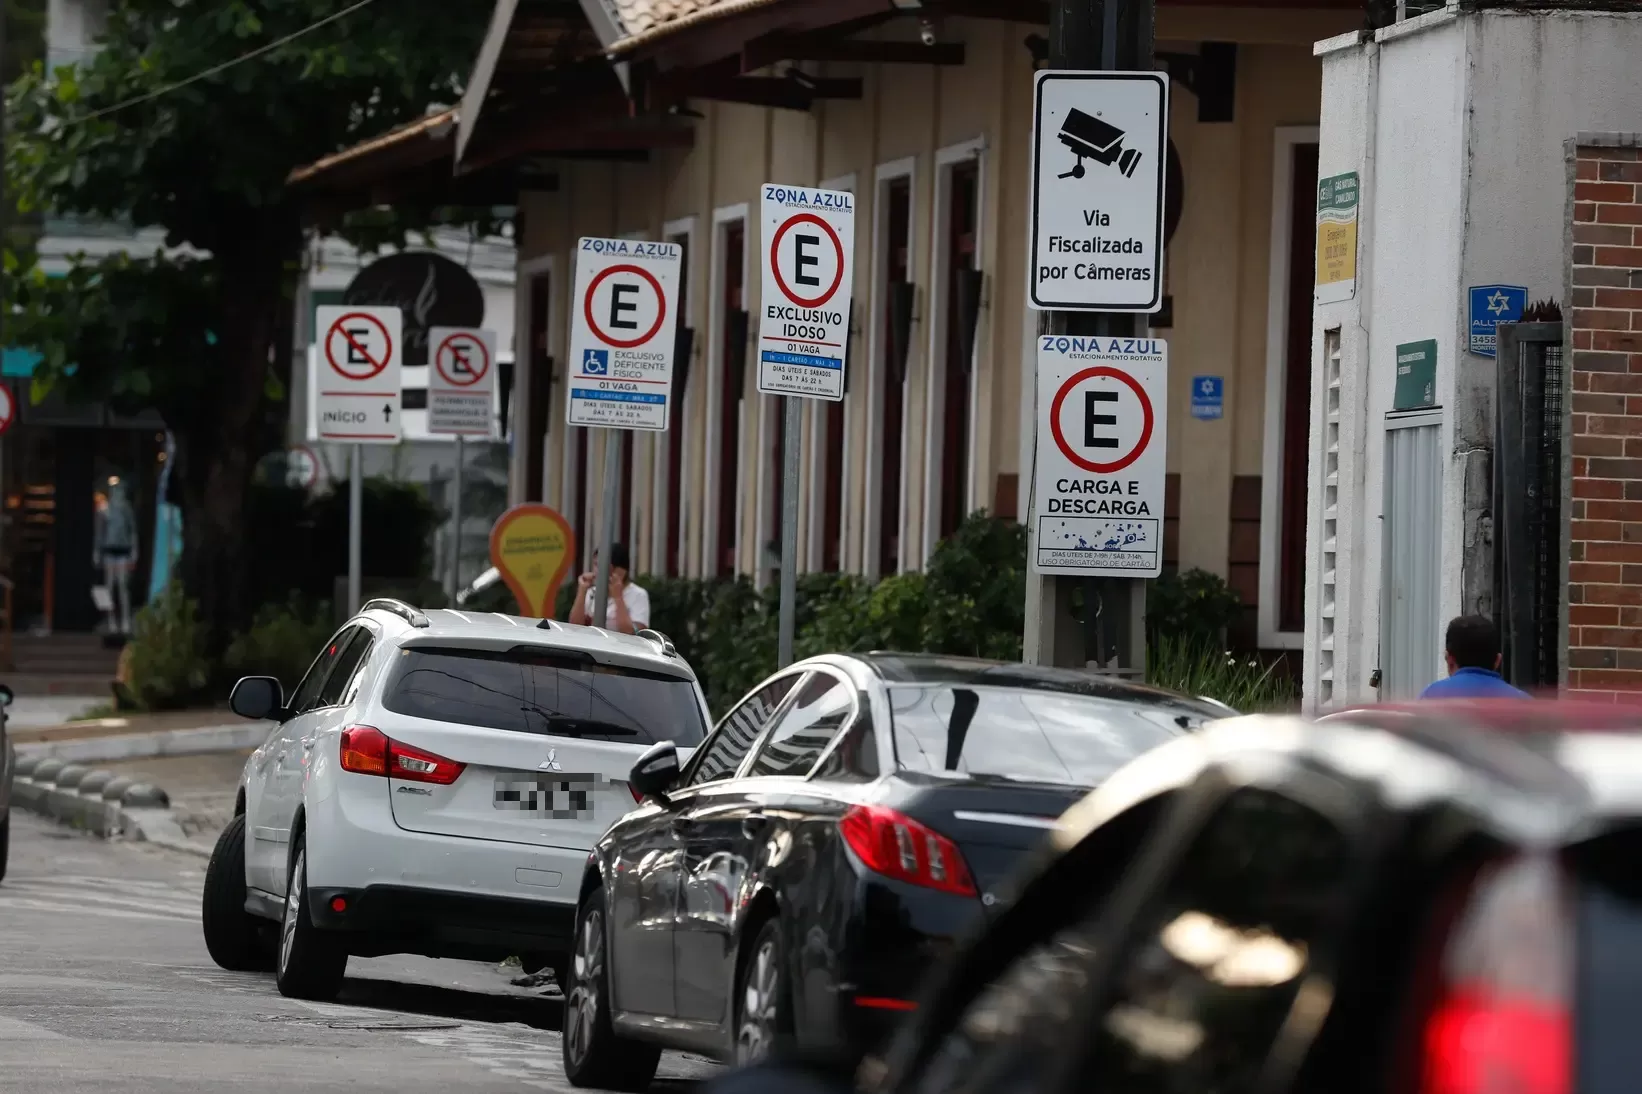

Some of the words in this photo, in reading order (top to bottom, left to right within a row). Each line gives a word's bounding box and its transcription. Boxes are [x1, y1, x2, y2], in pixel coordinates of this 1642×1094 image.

[766, 187, 808, 204] ZONA
[813, 192, 852, 209] AZUL
[785, 202, 828, 211] ESTACIONAMENTO
[829, 206, 852, 214] ROTATIVO
[1083, 209, 1110, 227] Via
[582, 239, 628, 253] ZONA
[634, 243, 677, 257] AZUL
[1048, 236, 1143, 254] Fiscalizada
[795, 234, 820, 287] E
[1039, 266, 1068, 283] por
[1074, 263, 1151, 281] Câmeras
[609, 283, 640, 330] E
[767, 305, 842, 325] EXCLUSIVO
[783, 323, 826, 340] IDOSO
[347, 328, 369, 364] E
[787, 343, 797, 352] 01
[799, 344, 820, 354] VAGA
[1043, 337, 1100, 354] ZONA
[1108, 339, 1162, 354] AZUL
[452, 345, 473, 374] E
[614, 350, 665, 361] EXCLUSIVO
[1069, 353, 1129, 361] ESTACIONAMENTO
[613, 360, 665, 371] DEFICIENTE
[613, 369, 642, 379] FÍSICO
[772, 365, 785, 373] DIAS
[599, 381, 609, 389] 01
[612, 382, 638, 391] VAGA
[323, 411, 367, 423] INÍCIO
[1084, 390, 1119, 449] E
[1056, 478, 1122, 495] CARGA
[1128, 480, 1139, 495] E
[1048, 498, 1150, 515] DESCARGA
[1059, 558, 1109, 567] OBRIGATÓRIO
